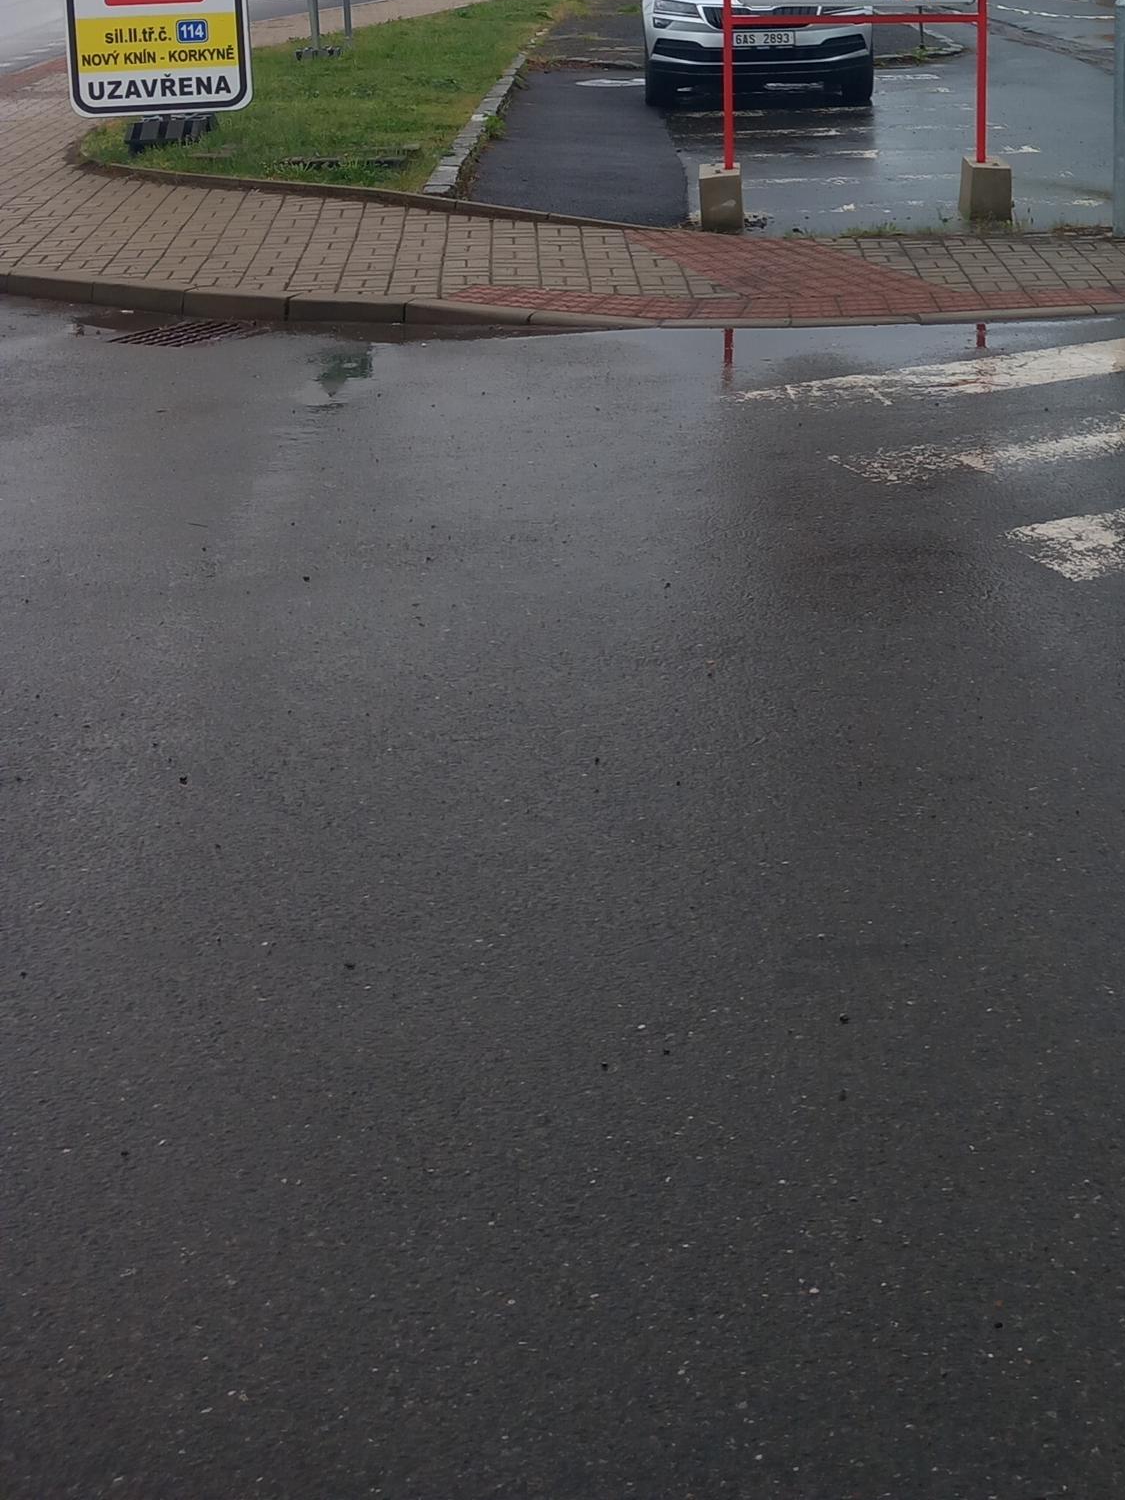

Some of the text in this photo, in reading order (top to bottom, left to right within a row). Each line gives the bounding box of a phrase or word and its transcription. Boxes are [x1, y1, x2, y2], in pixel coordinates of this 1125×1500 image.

[180, 24, 205, 39] 114
[735, 33, 790, 46] 6AS 2893
[81, 50, 120, 67] NOVÝ
[124, 48, 157, 65] KNÍN
[168, 45, 235, 63] KORKYNĚ
[88, 73, 232, 101] UZAVŘENA
